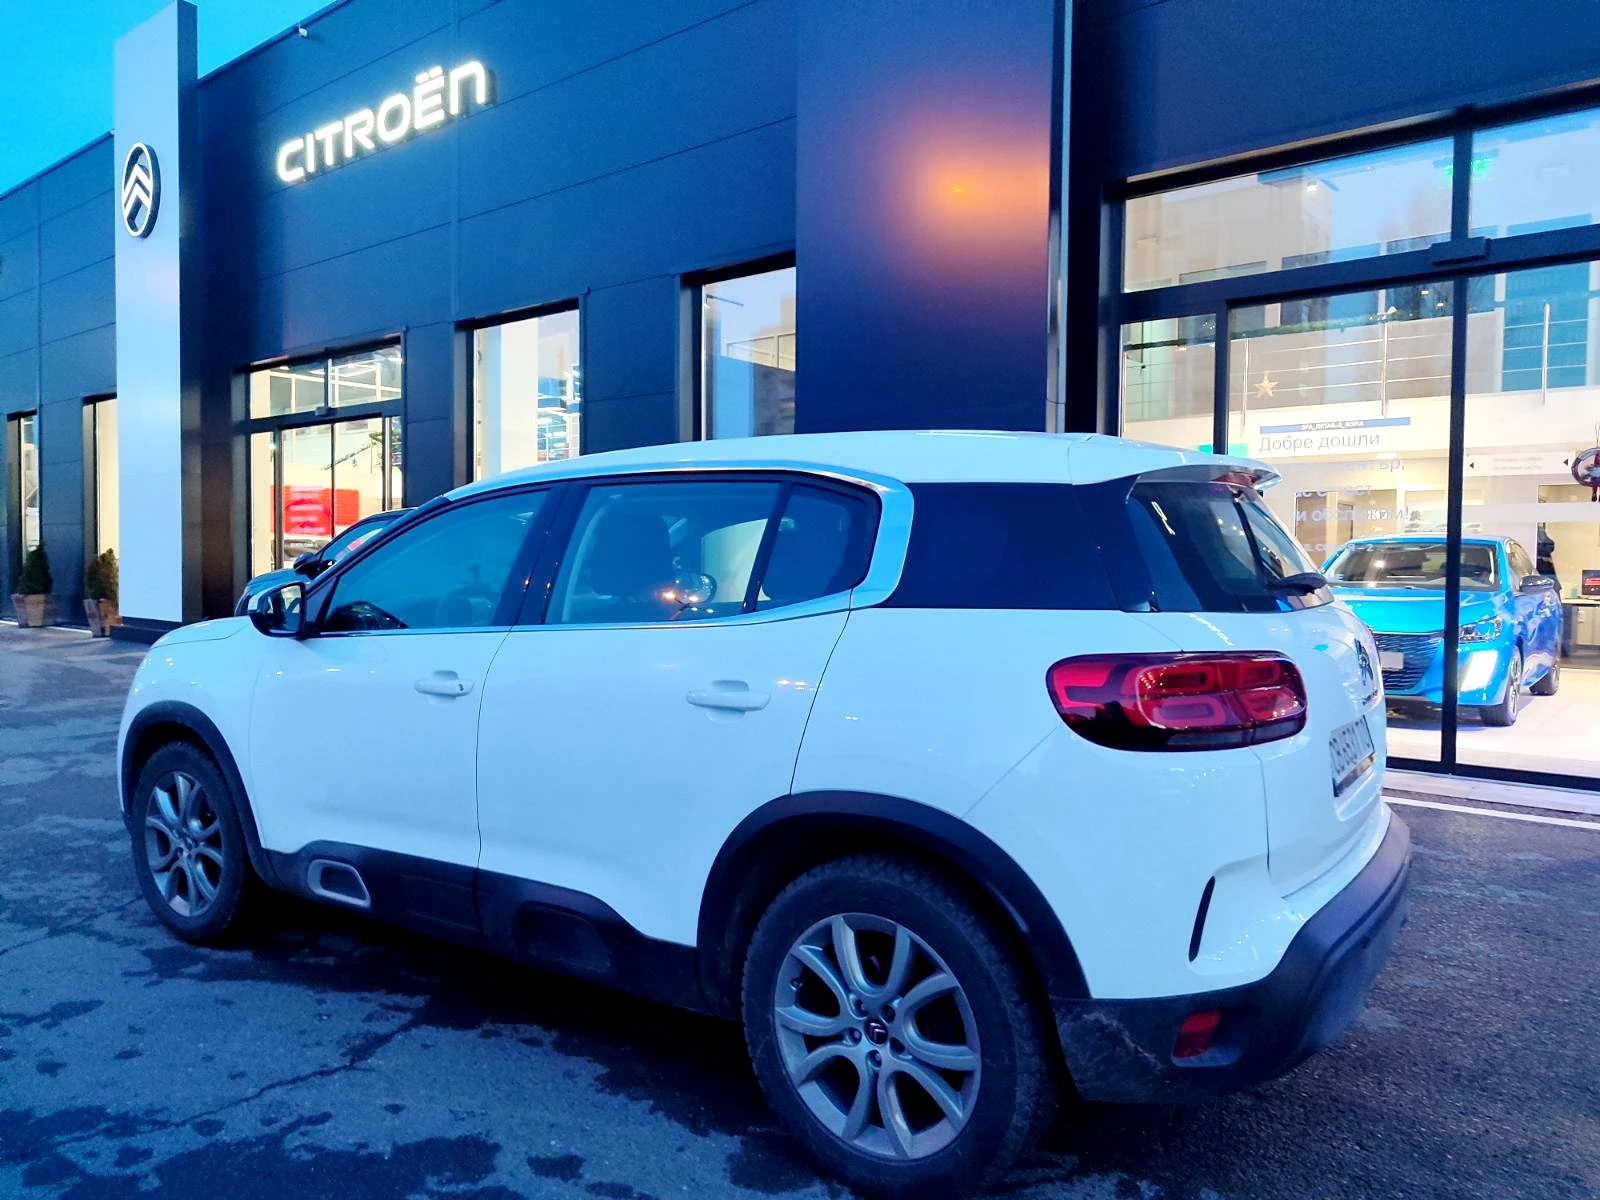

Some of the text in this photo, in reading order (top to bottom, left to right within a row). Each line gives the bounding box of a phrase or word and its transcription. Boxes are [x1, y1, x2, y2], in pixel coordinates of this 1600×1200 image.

[277, 61, 486, 182] CITROËN
[1259, 434, 1380, 453] Добре дошли
